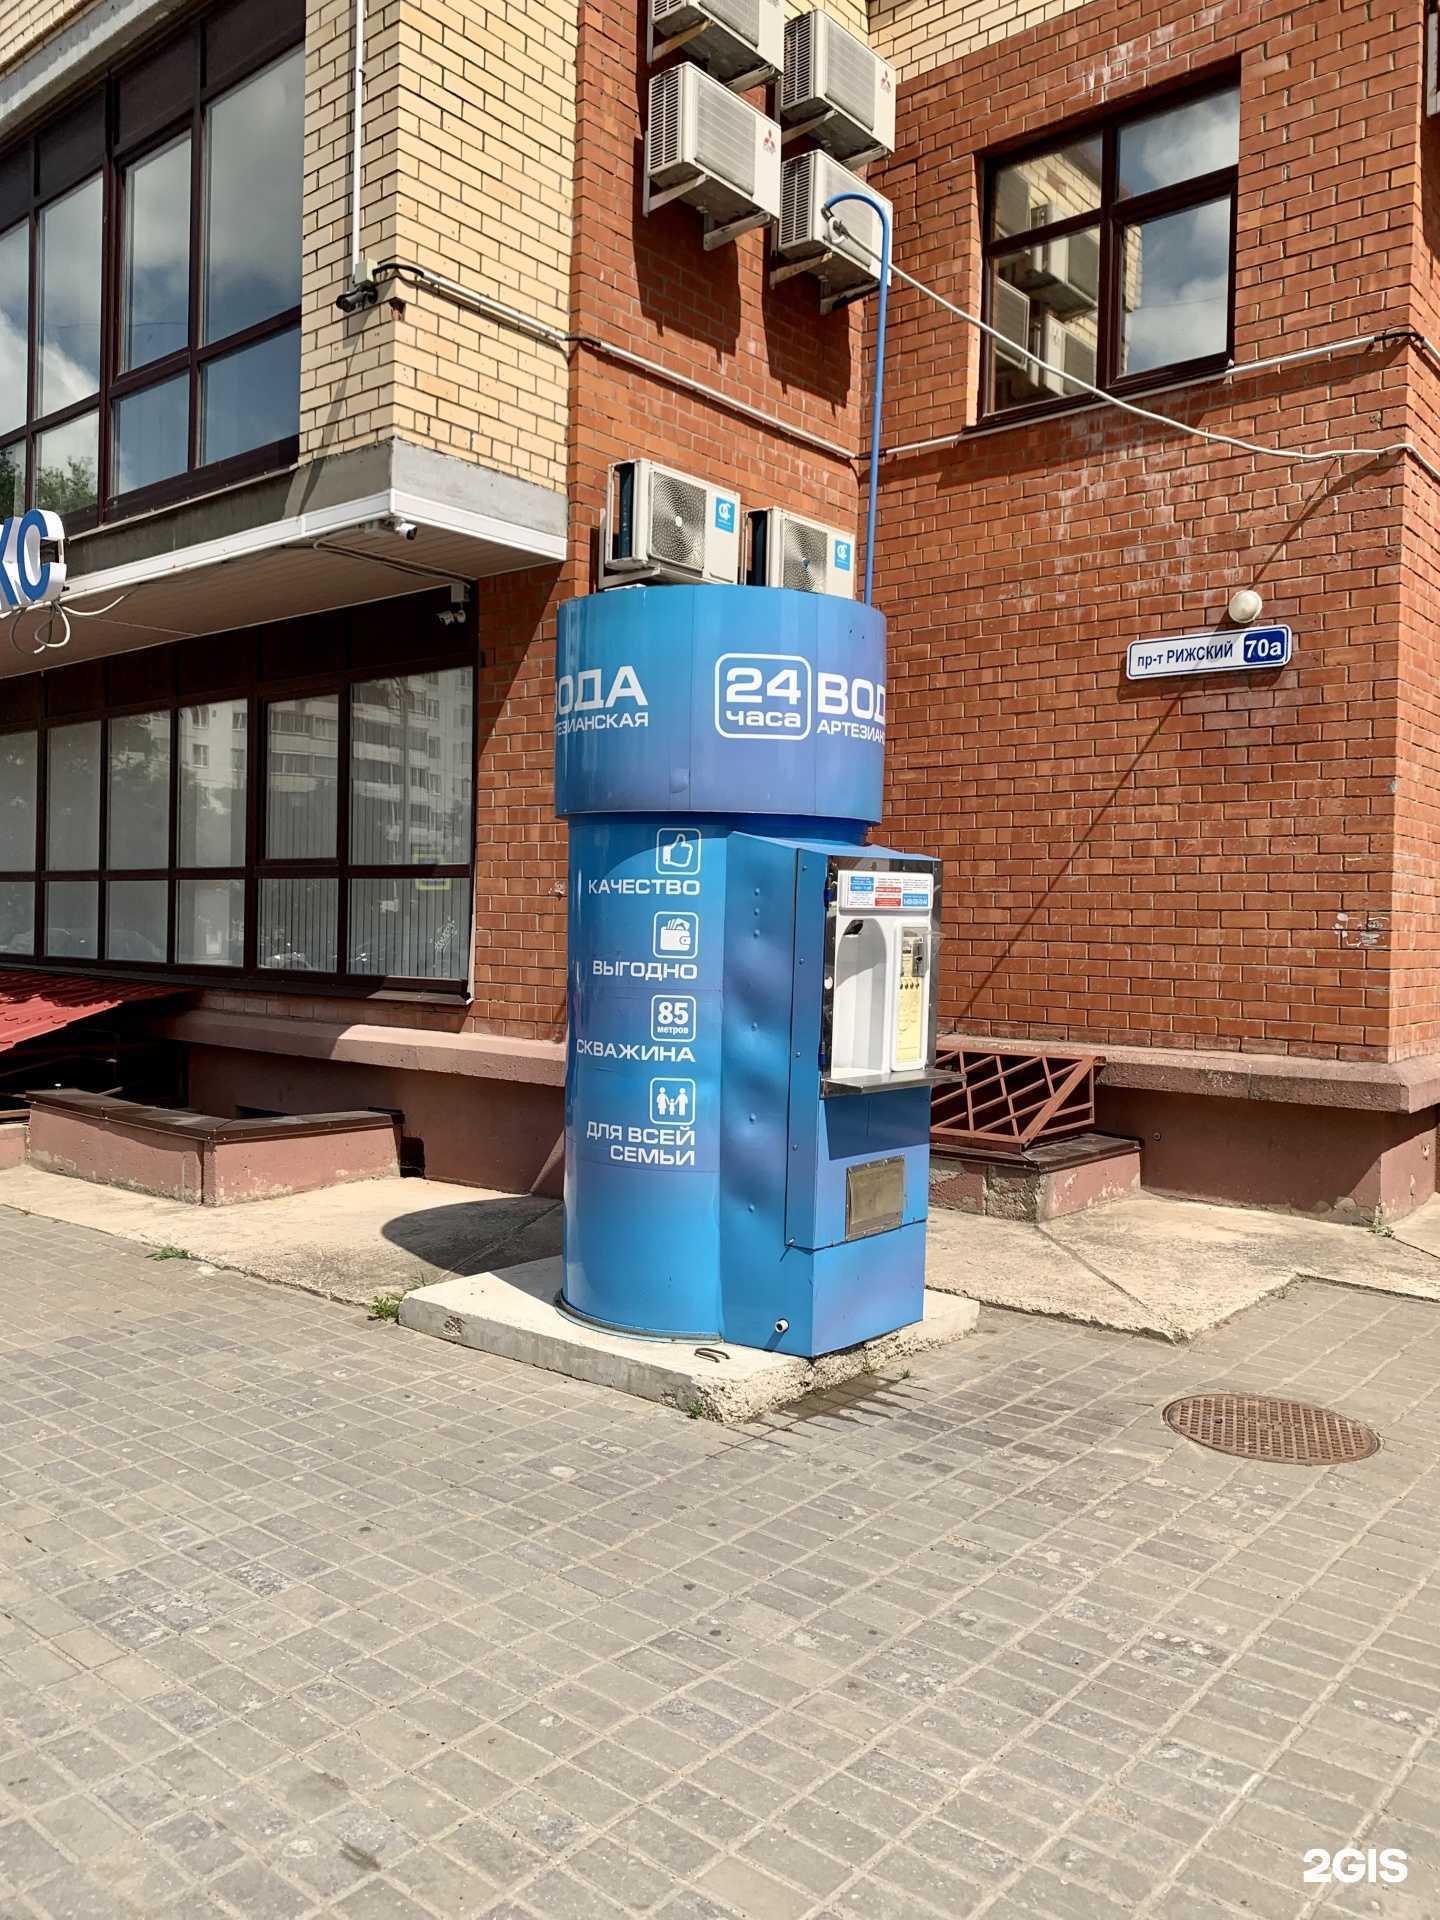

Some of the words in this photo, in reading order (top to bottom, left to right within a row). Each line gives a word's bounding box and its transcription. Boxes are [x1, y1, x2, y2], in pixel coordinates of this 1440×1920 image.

[1137, 653, 1163, 669] пр-т
[1166, 640, 1233, 664] РИЖСКИЙ
[1245, 638, 1282, 658] 70а
[555, 665, 648, 716] ОДА
[726, 667, 801, 705] 24
[726, 711, 801, 728] часа
[588, 879, 700, 896] КАЧЕСТВО
[592, 960, 698, 981] ВЫГОДНО
[657, 1001, 689, 1024] 85
[657, 1026, 689, 1035] метров
[576, 1039, 696, 1063] СКВАЖИНА
[586, 1121, 622, 1140] ДЛЯ
[628, 1125, 695, 1146] ВСЕЙ
[610, 1145, 695, 1166] СЕМЬИ
